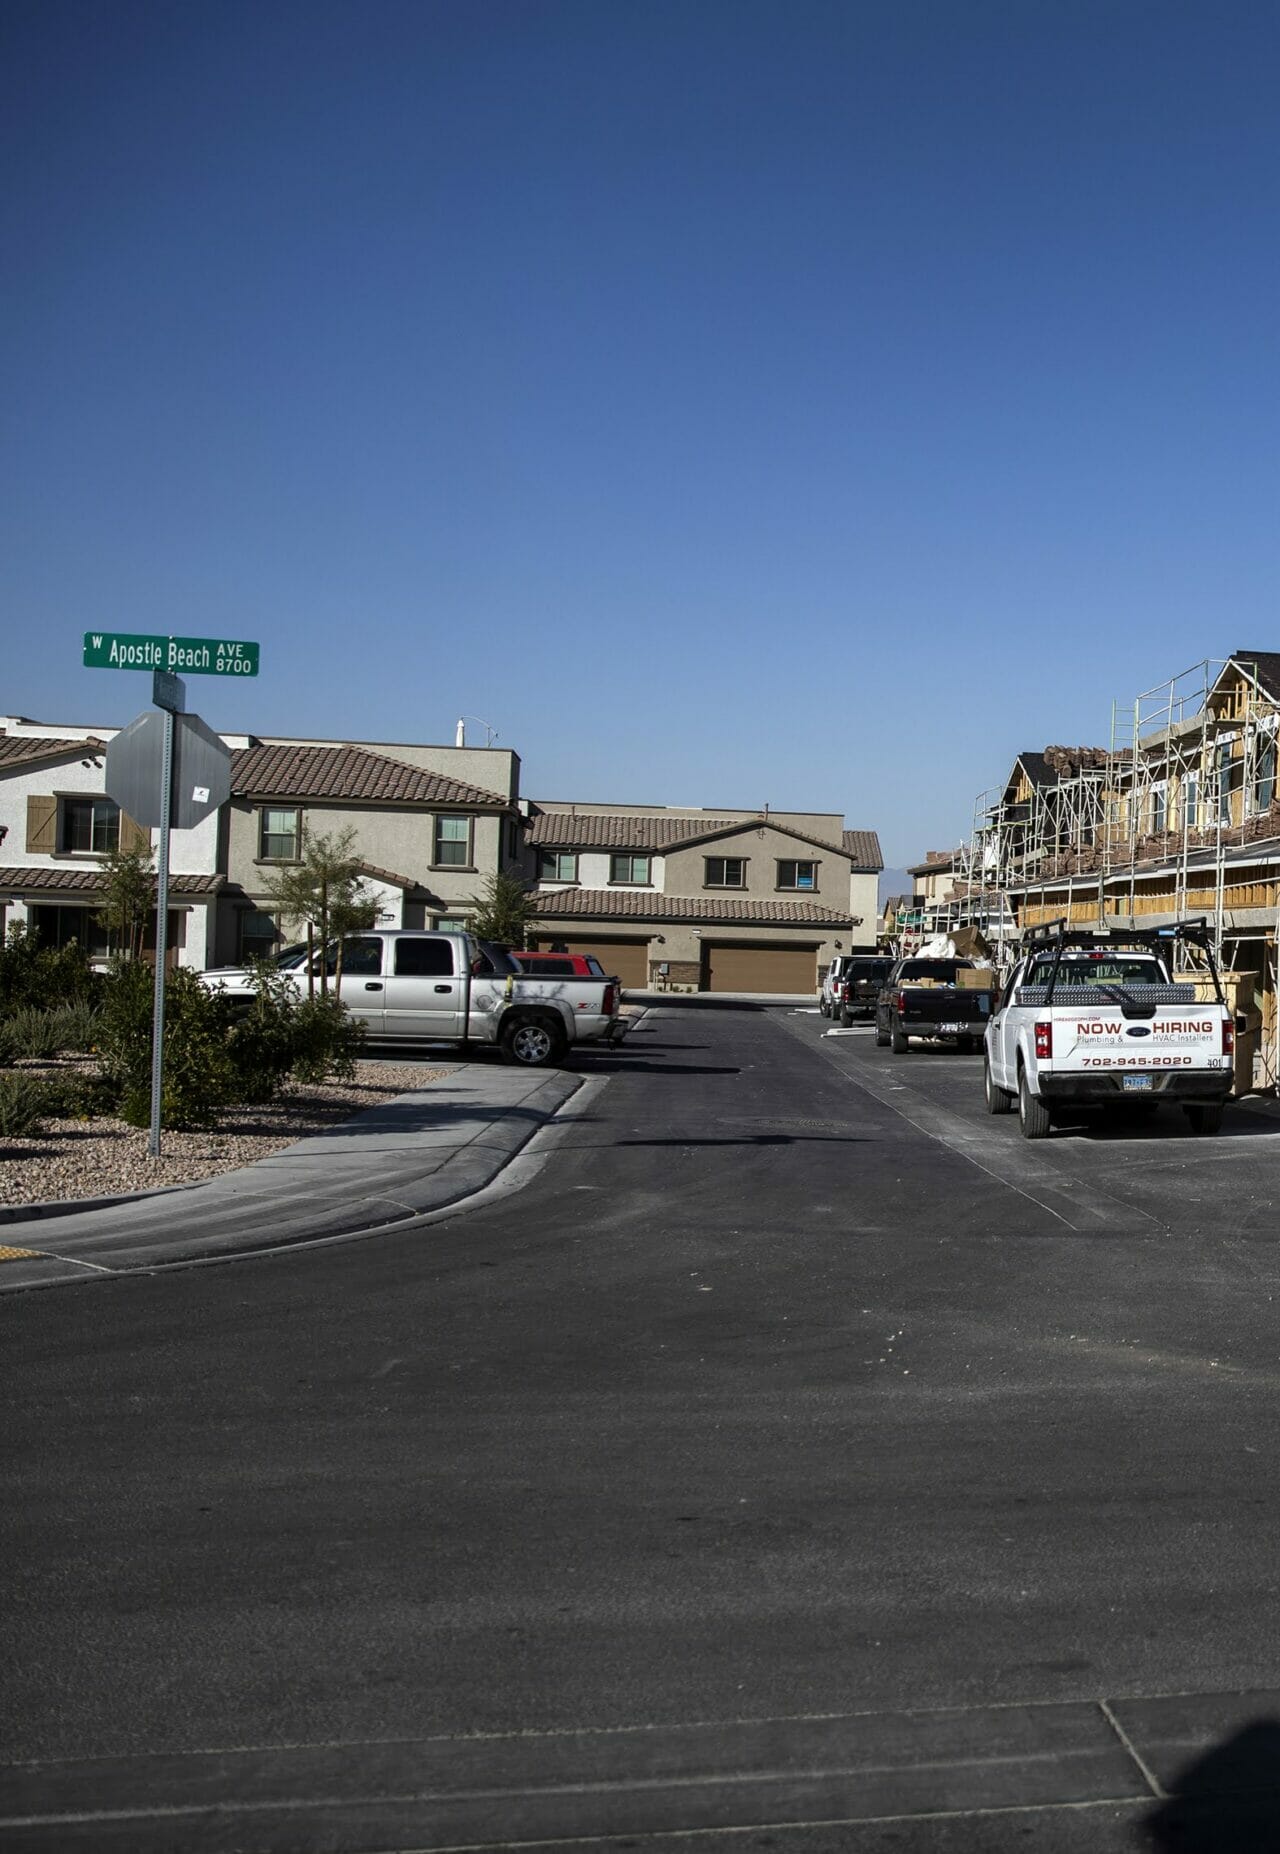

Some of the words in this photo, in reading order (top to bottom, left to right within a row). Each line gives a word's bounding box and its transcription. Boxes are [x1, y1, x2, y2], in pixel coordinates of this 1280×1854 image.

[92, 635, 103, 649] W
[109, 639, 161, 668] Apostle
[168, 643, 209, 668] Beach
[217, 643, 244, 658] AVE
[216, 659, 251, 673] 8700
[1077, 1023, 1122, 1035] NOW
[1152, 1021, 1213, 1033] HIRING
[1077, 1034, 1115, 1044] Plumbing
[1117, 1034, 1123, 1043] &
[1152, 1034, 1175, 1042] HVAC
[1178, 1033, 1213, 1042] Installers
[1082, 1056, 1192, 1066] 702-945-2020
[1208, 1058, 1222, 1068] 401
